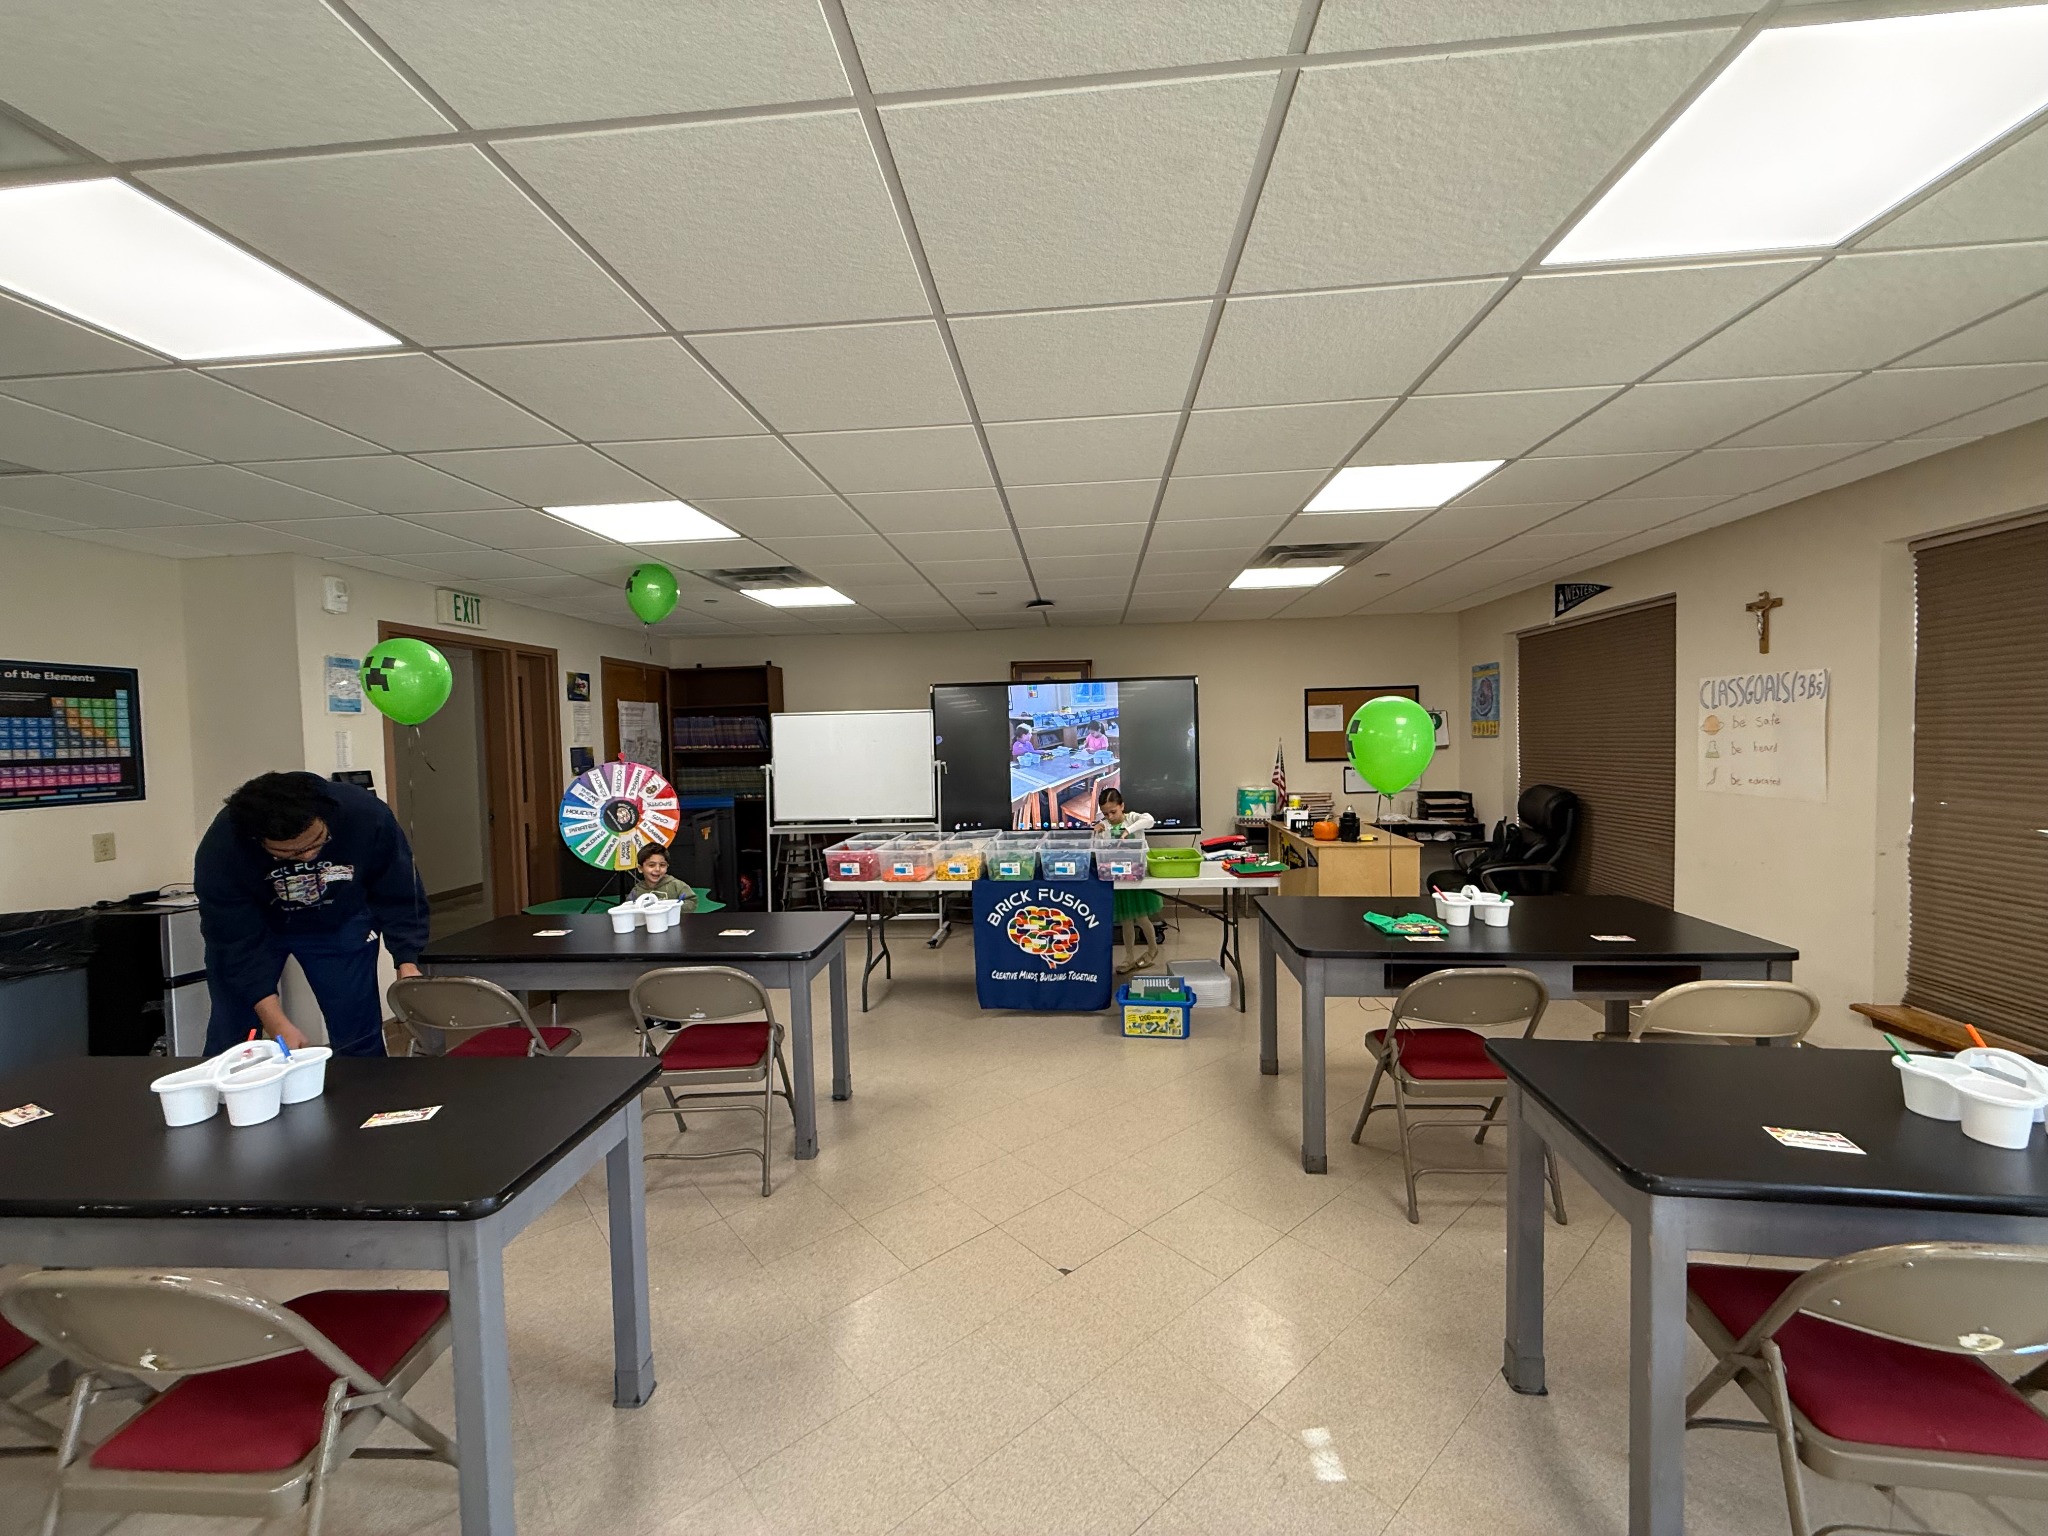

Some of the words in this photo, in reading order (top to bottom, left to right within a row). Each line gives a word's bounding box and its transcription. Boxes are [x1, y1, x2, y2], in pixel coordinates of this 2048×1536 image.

[1564, 584, 1600, 601] WESTERN
[454, 594, 481, 624] EXIT
[4, 669, 18, 679] of
[21, 670, 41, 680] the
[44, 671, 96, 683] Elements
[1732, 715, 1747, 728] be
[1731, 741, 1742, 756] be
[1730, 773, 1743, 786] be
[987, 889, 1032, 927] BRICK
[1038, 888, 1100, 929] FUSION
[1068, 970, 1098, 982] TOGETHER
